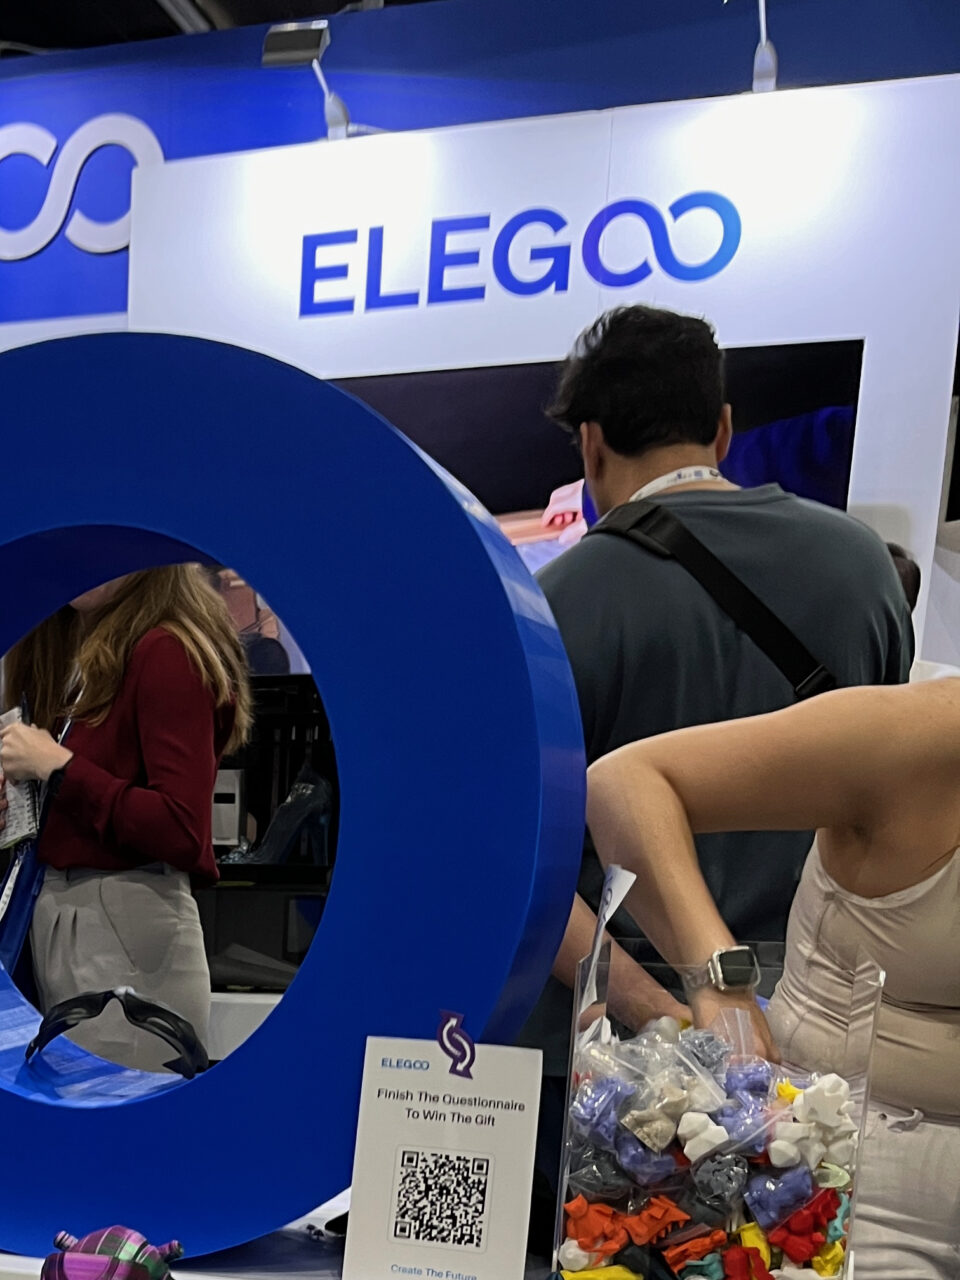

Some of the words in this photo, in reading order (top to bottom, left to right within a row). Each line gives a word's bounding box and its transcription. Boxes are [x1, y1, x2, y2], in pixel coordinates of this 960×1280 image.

[299, 190, 742, 318] ELEGOO
[381, 1057, 430, 1071] ELEGOO
[377, 1087, 413, 1101] Finish
[418, 1090, 440, 1104] The
[442, 1093, 525, 1112] Questionnaire
[406, 1107, 420, 1120] To
[422, 1108, 447, 1123] Win
[451, 1111, 472, 1124] The
[474, 1113, 496, 1127] Gift
[390, 1263, 423, 1276] Create
[425, 1267, 444, 1278] The
